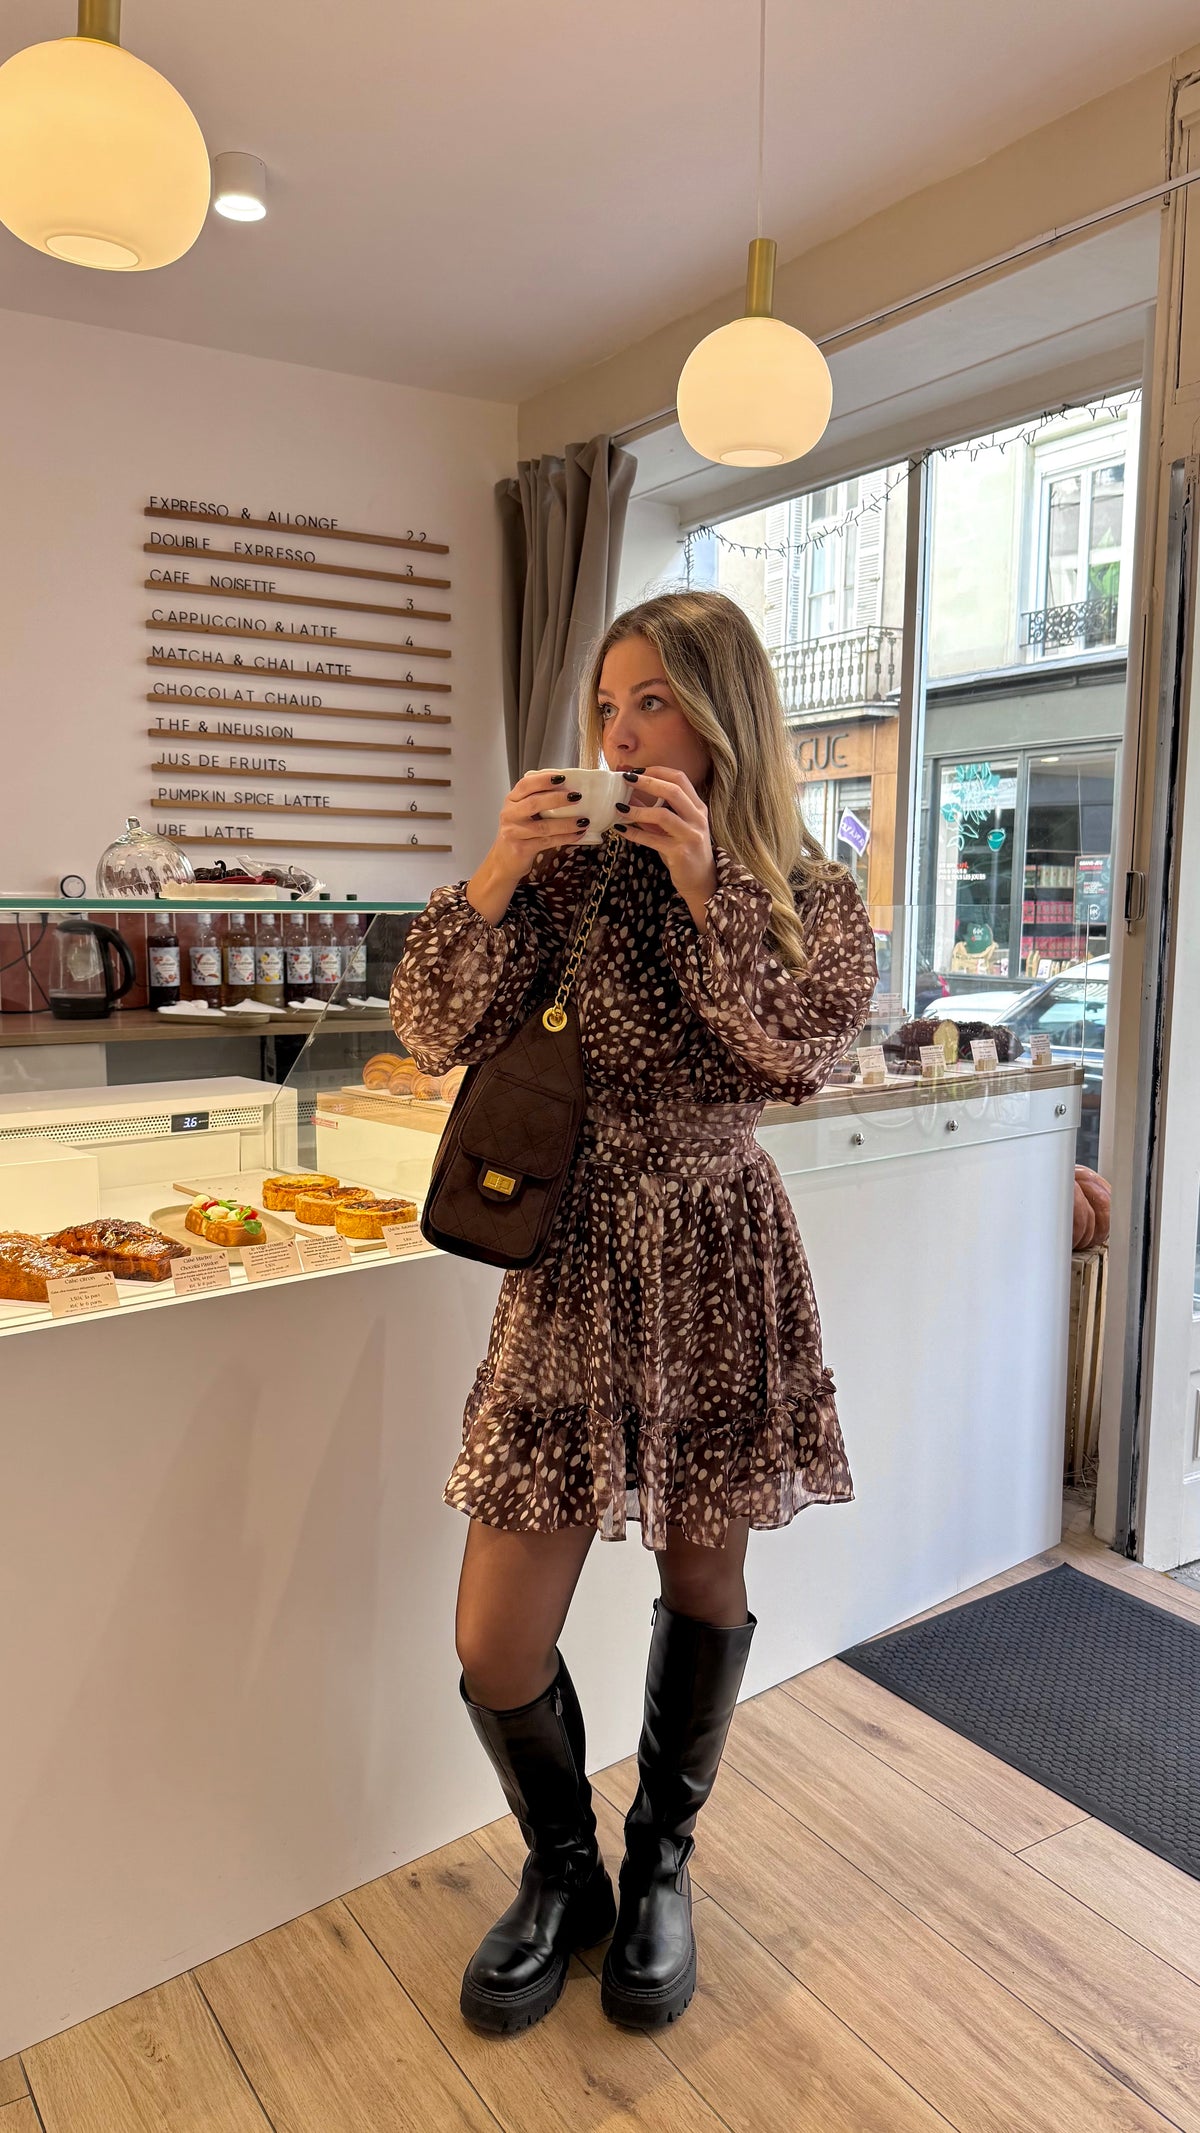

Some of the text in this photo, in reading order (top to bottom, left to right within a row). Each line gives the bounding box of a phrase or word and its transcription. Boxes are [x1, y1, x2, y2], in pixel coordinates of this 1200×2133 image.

[149, 495, 229, 517] EXPRESSO
[240, 507, 251, 520] &
[150, 531, 414, 577] DOUBLE EXPRESSO 3
[149, 569, 414, 610] CAFE NOISETTE 3
[151, 608, 414, 647] CAPPUCCINO & LATTE 4
[151, 645, 414, 683] MATCHA & CHAI LATTE 6
[153, 682, 255, 703] CHOCOLAT
[264, 692, 322, 708] CHAUD
[155, 717, 415, 747] THE & INFUSION 4
[156, 752, 416, 779] JUS DE FRUITS 5
[158, 787, 418, 813] PUMPKIN SPICE LATTE 6
[156, 823, 419, 846] UBE LATTE 6
